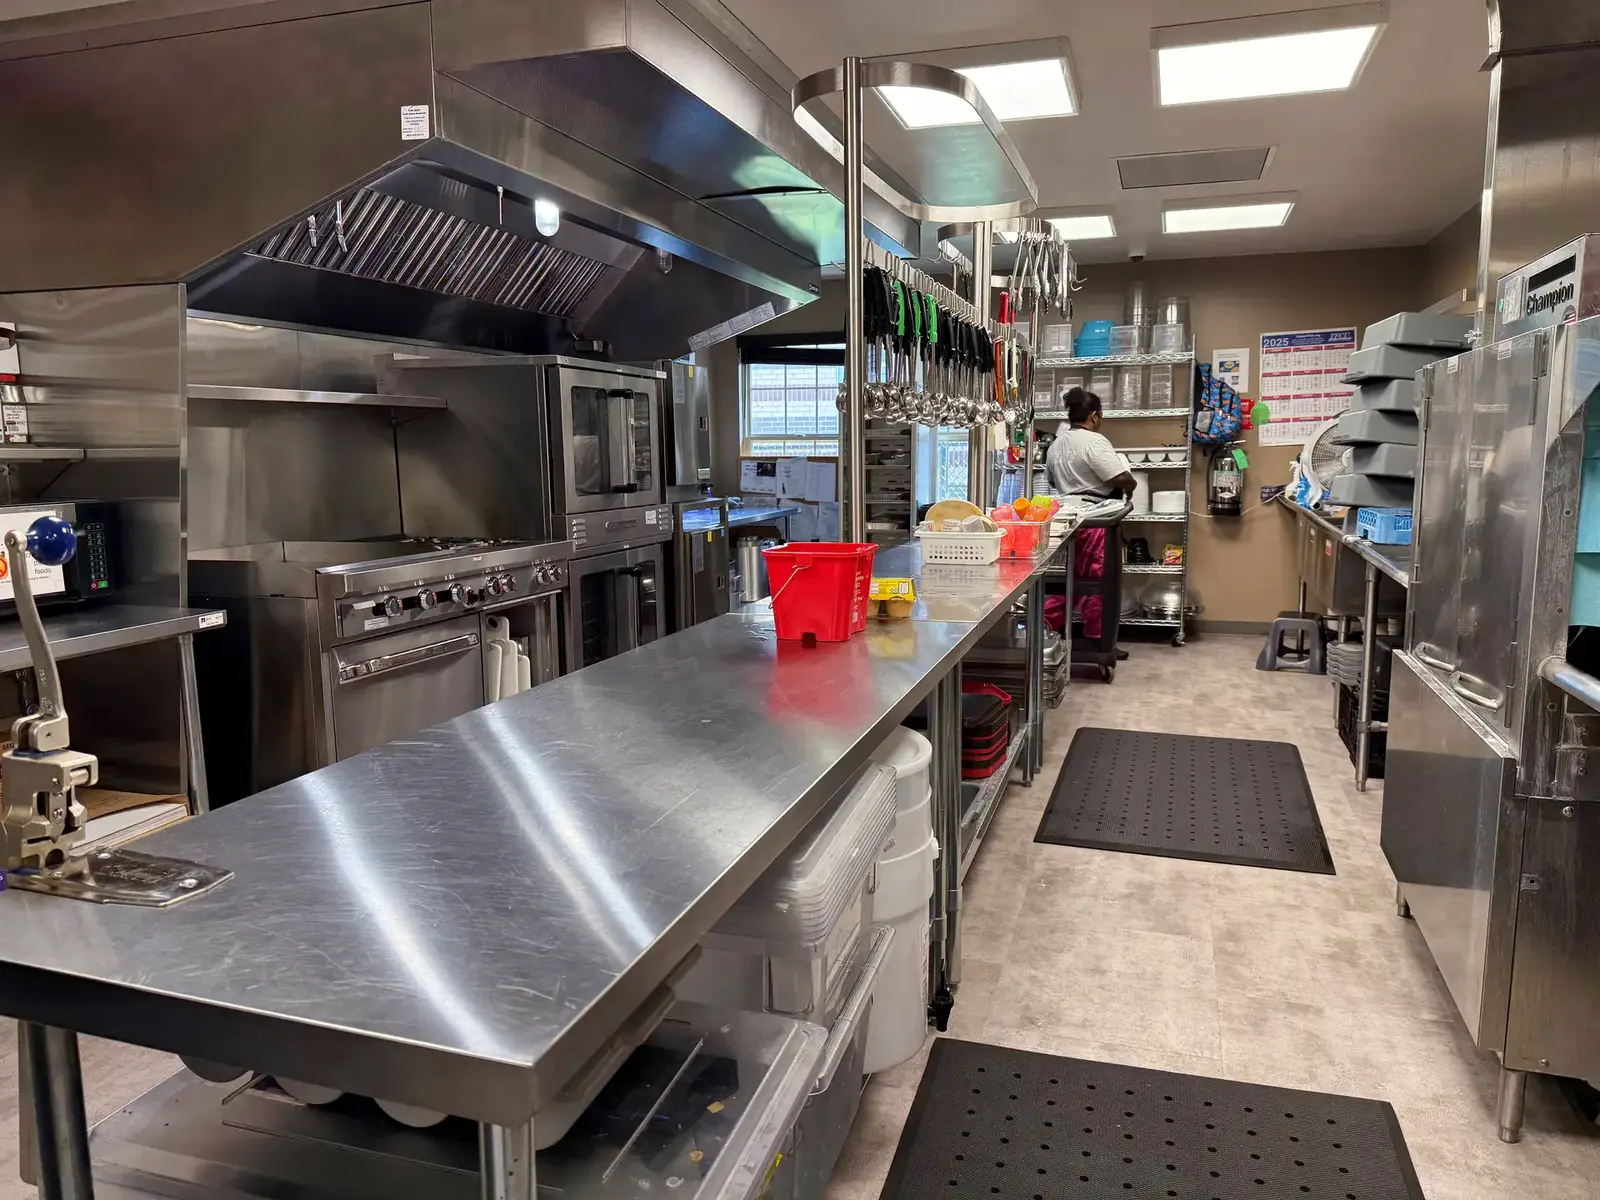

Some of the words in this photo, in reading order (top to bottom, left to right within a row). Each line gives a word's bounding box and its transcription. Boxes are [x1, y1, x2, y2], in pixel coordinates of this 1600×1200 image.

[1527, 280, 1574, 316] Champion
[1263, 338, 1289, 348] 2025
[34, 567, 52, 575] foods
